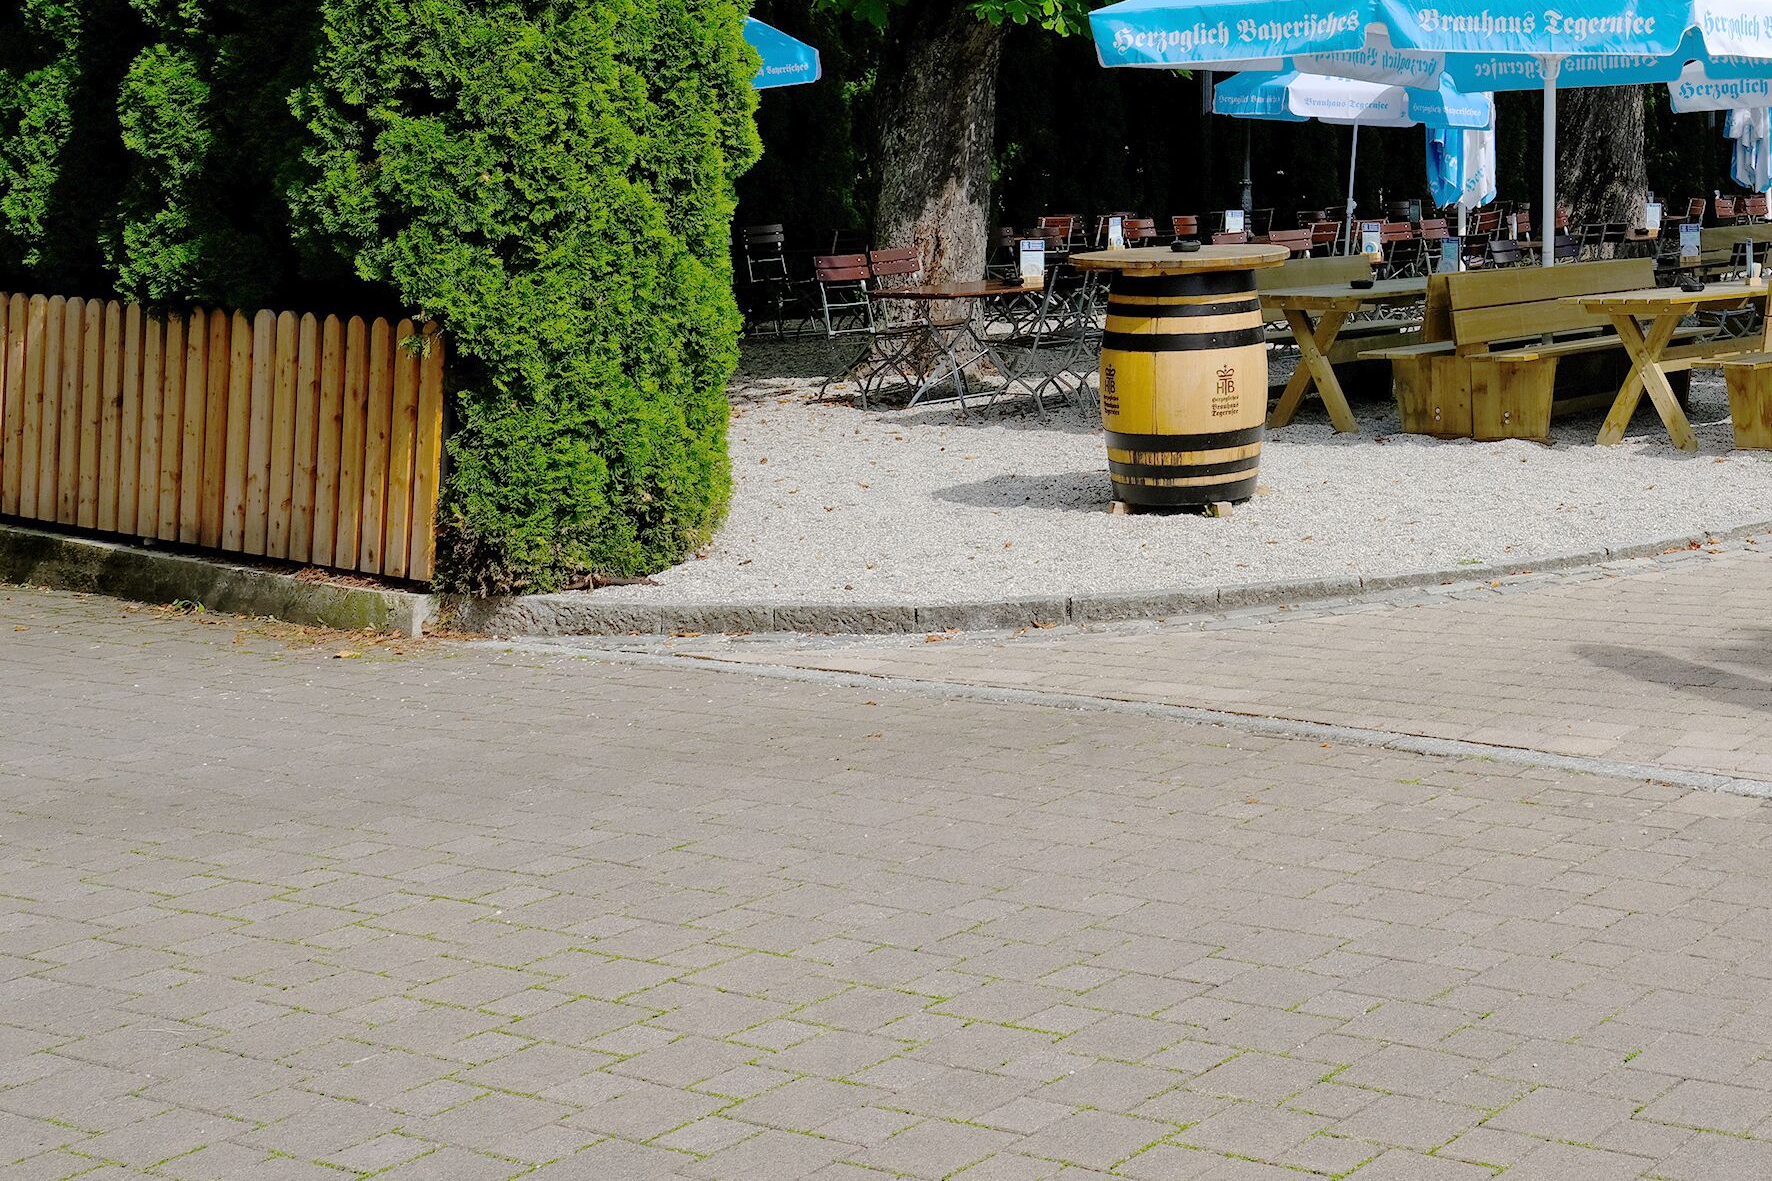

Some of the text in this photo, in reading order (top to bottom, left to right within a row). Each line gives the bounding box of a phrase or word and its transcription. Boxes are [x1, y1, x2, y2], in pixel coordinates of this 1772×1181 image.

[1417, 9, 1536, 40] Brauhaus
[1703, 9, 1760, 43] Herzoglich
[1112, 21, 1230, 55] Herzoglich
[1679, 78, 1768, 100] Herzoglich
[1304, 97, 1346, 109] Brauhaus
[1216, 378, 1235, 396] HTB
